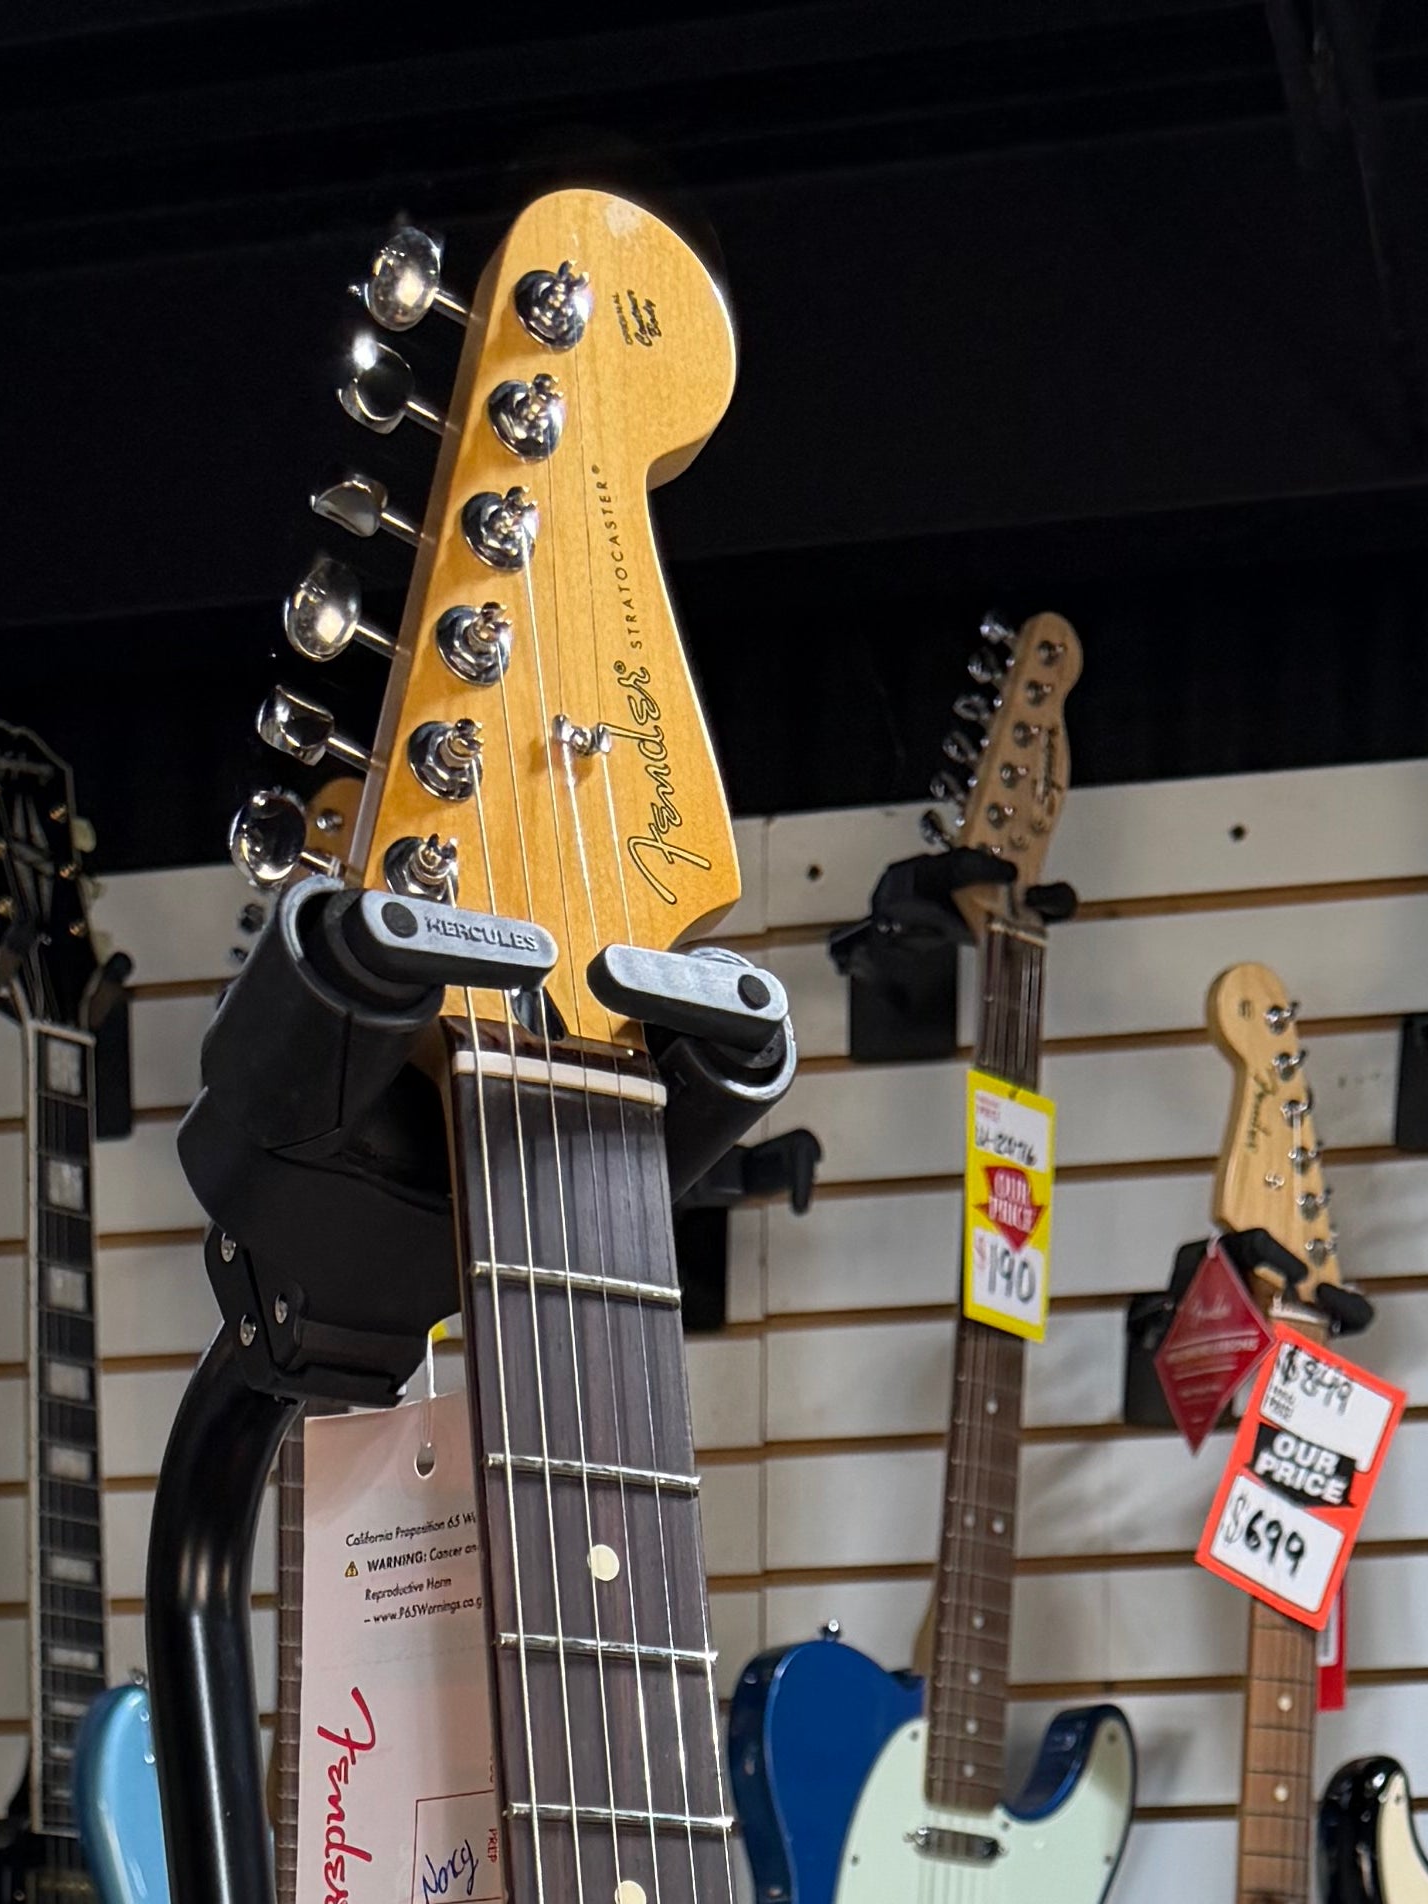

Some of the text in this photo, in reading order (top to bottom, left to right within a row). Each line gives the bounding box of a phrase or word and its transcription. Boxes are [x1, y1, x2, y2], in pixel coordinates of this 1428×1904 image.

[595, 480, 643, 650] STRATOCASTER
[599, 660, 710, 905] Fender
[424, 916, 539, 951] HERCULES
[993, 1170, 1030, 1201] OUR
[1274, 1431, 1340, 1474] OUR
[1254, 1458, 1350, 1505] PRICE
[345, 1530, 393, 1547] California
[367, 1551, 427, 1573] WARNING:
[464, 1544, 477, 1553] an
[365, 1582, 424, 1603] Reproductive
